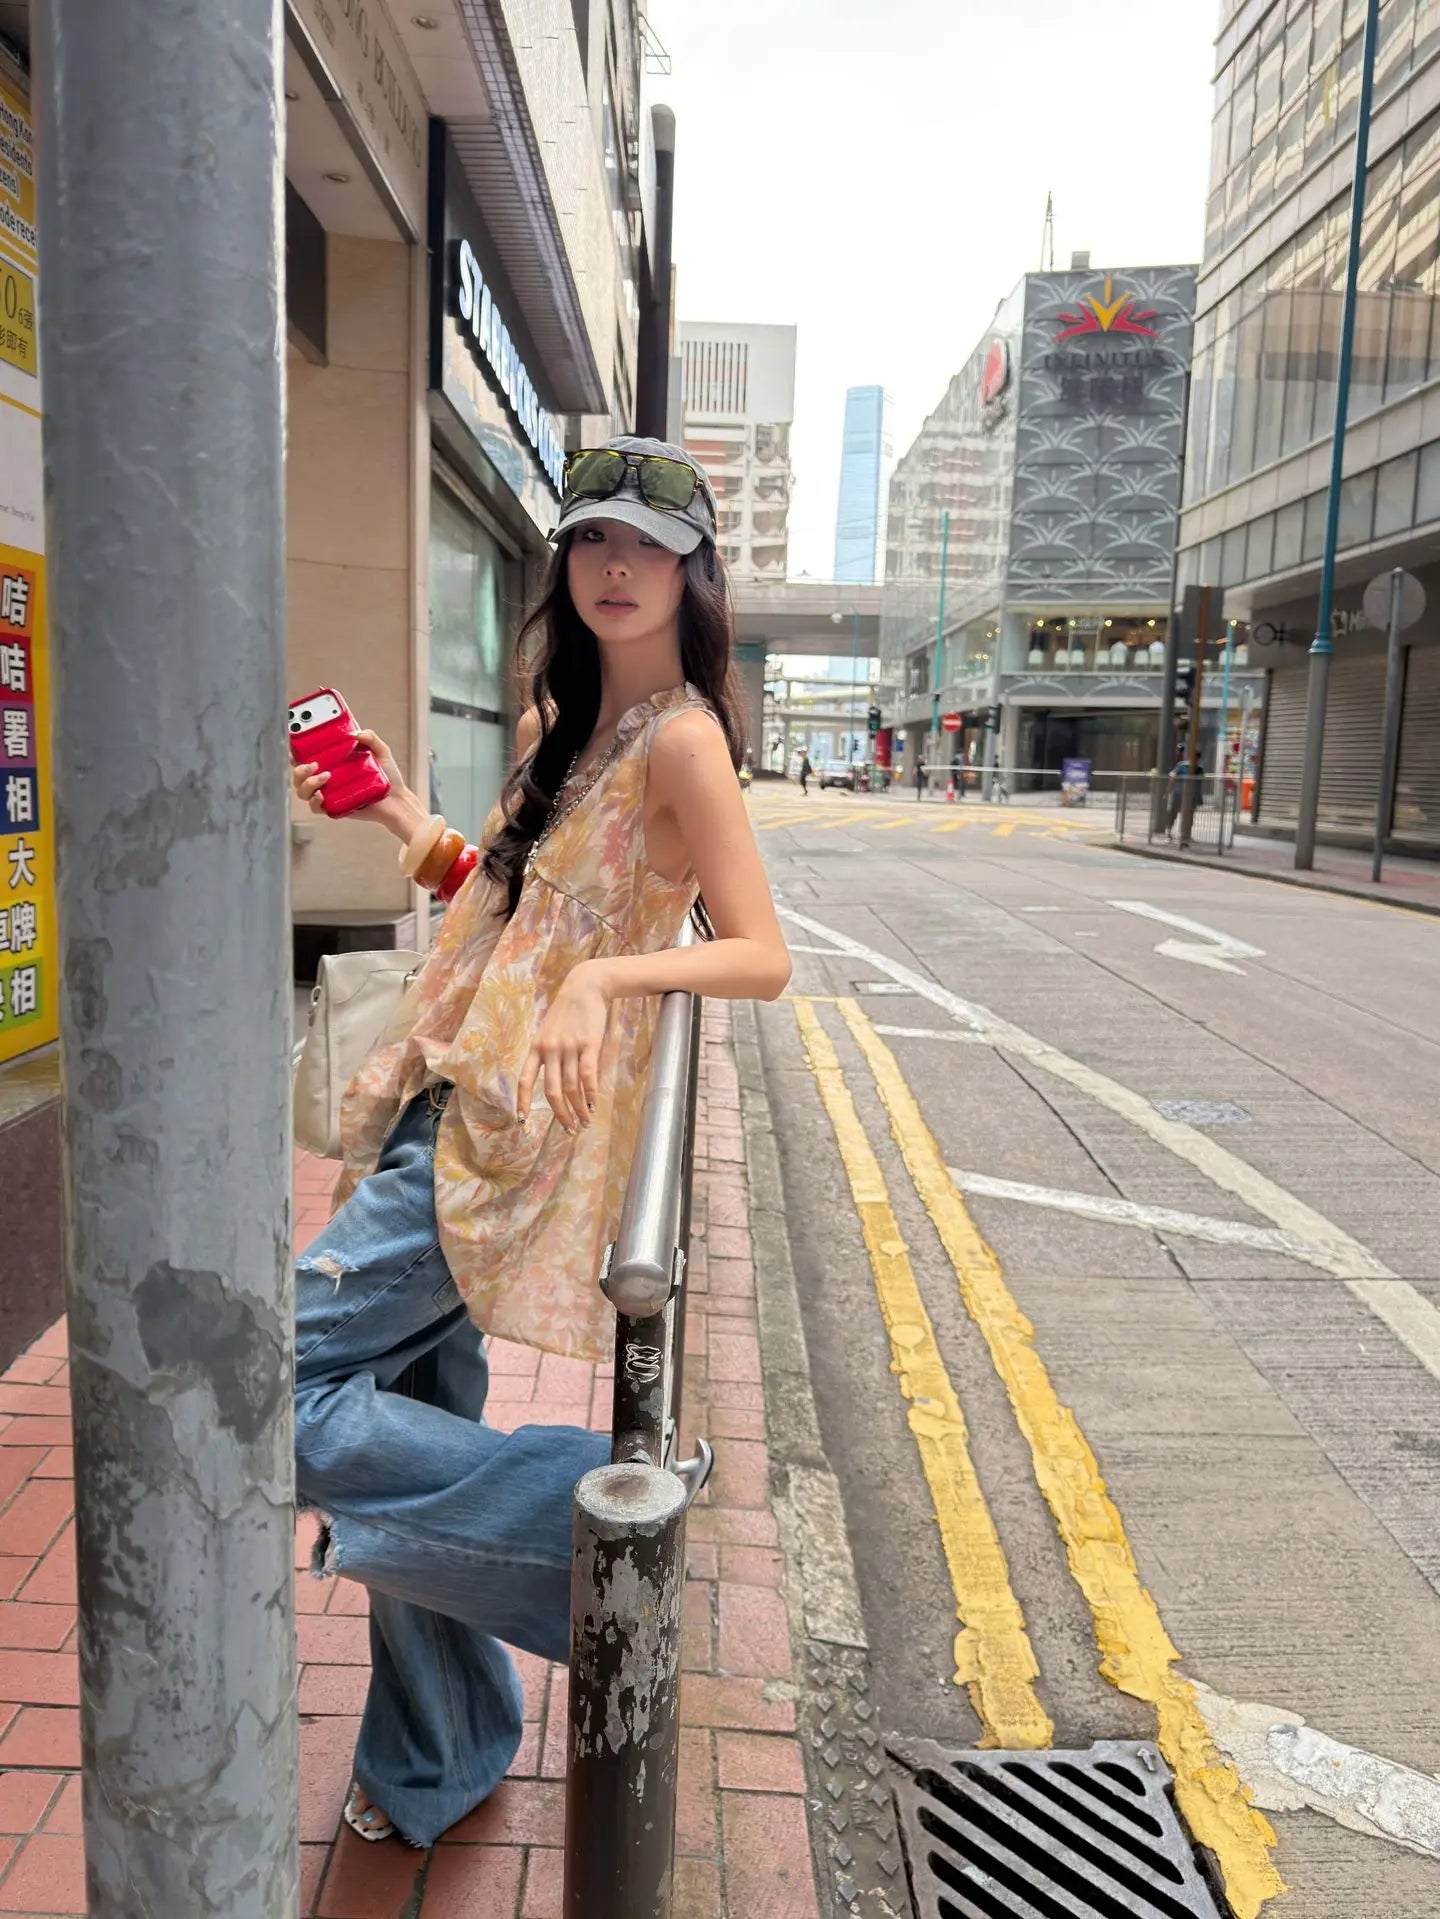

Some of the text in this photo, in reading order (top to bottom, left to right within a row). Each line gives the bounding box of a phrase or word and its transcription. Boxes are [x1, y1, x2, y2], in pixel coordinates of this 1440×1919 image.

[0, 135, 33, 176] esidents
[459, 239, 538, 448] STARBUCKS
[0, 964, 36, 1019] 相
